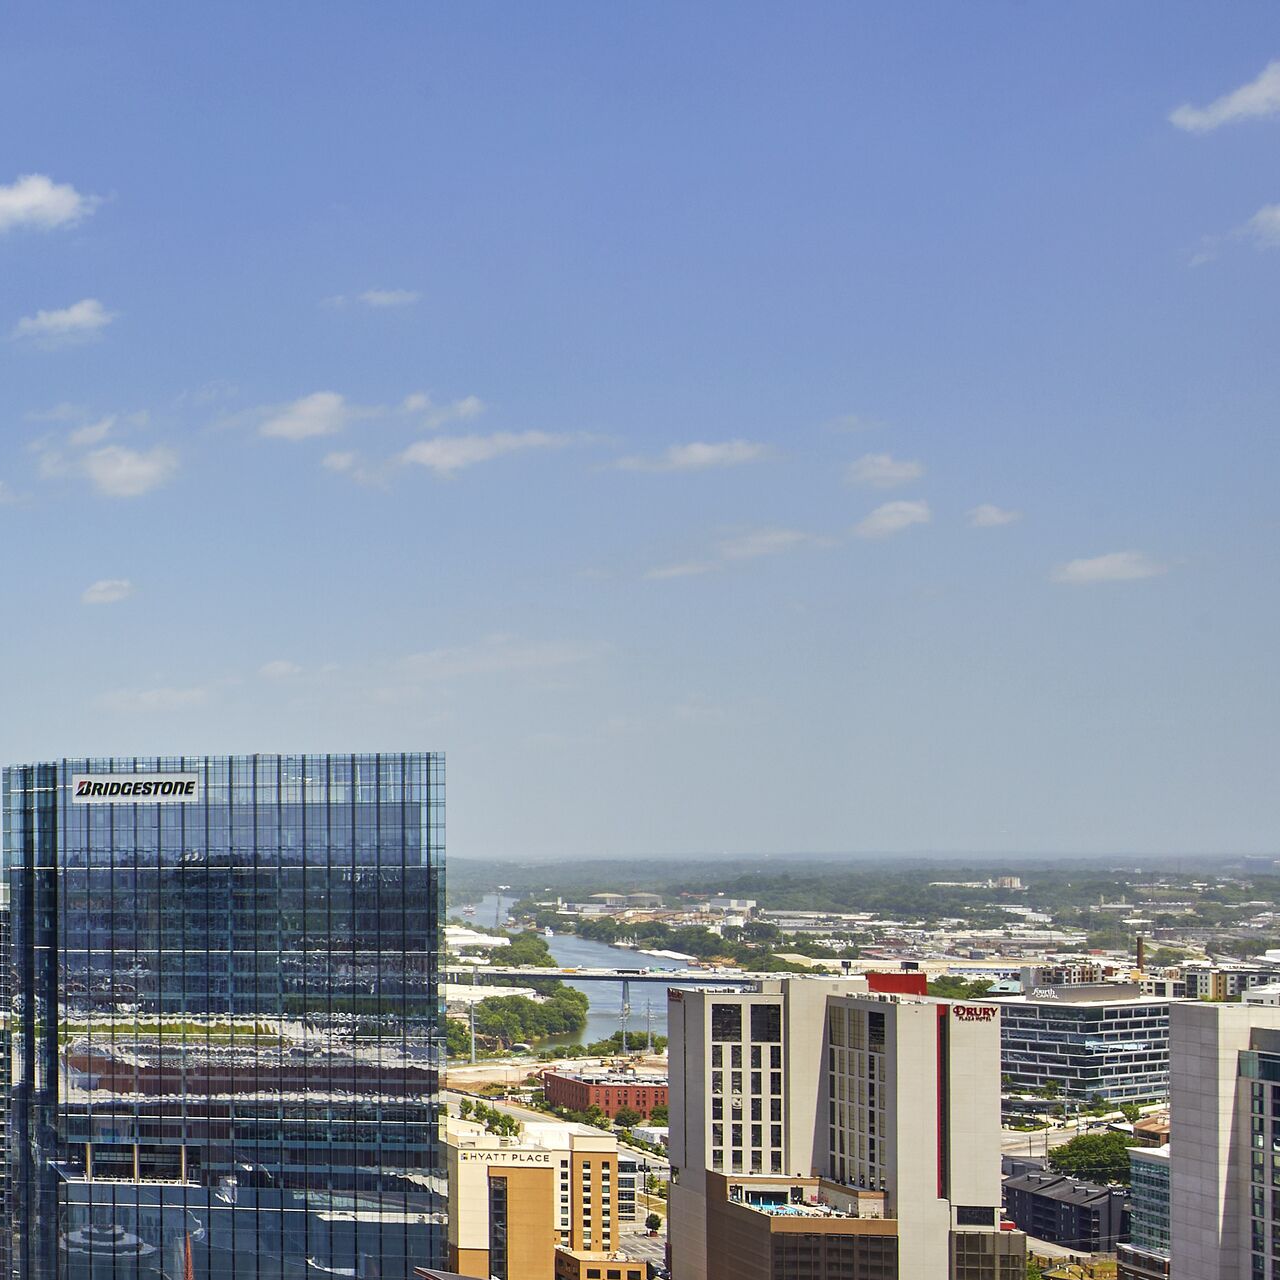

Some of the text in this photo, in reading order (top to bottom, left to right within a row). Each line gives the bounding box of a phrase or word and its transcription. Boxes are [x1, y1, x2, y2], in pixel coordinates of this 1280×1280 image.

[76, 781, 196, 796] BRIDGESTONE
[953, 1005, 998, 1018] DRURY
[470, 1153, 550, 1163] HYATT PLACE
